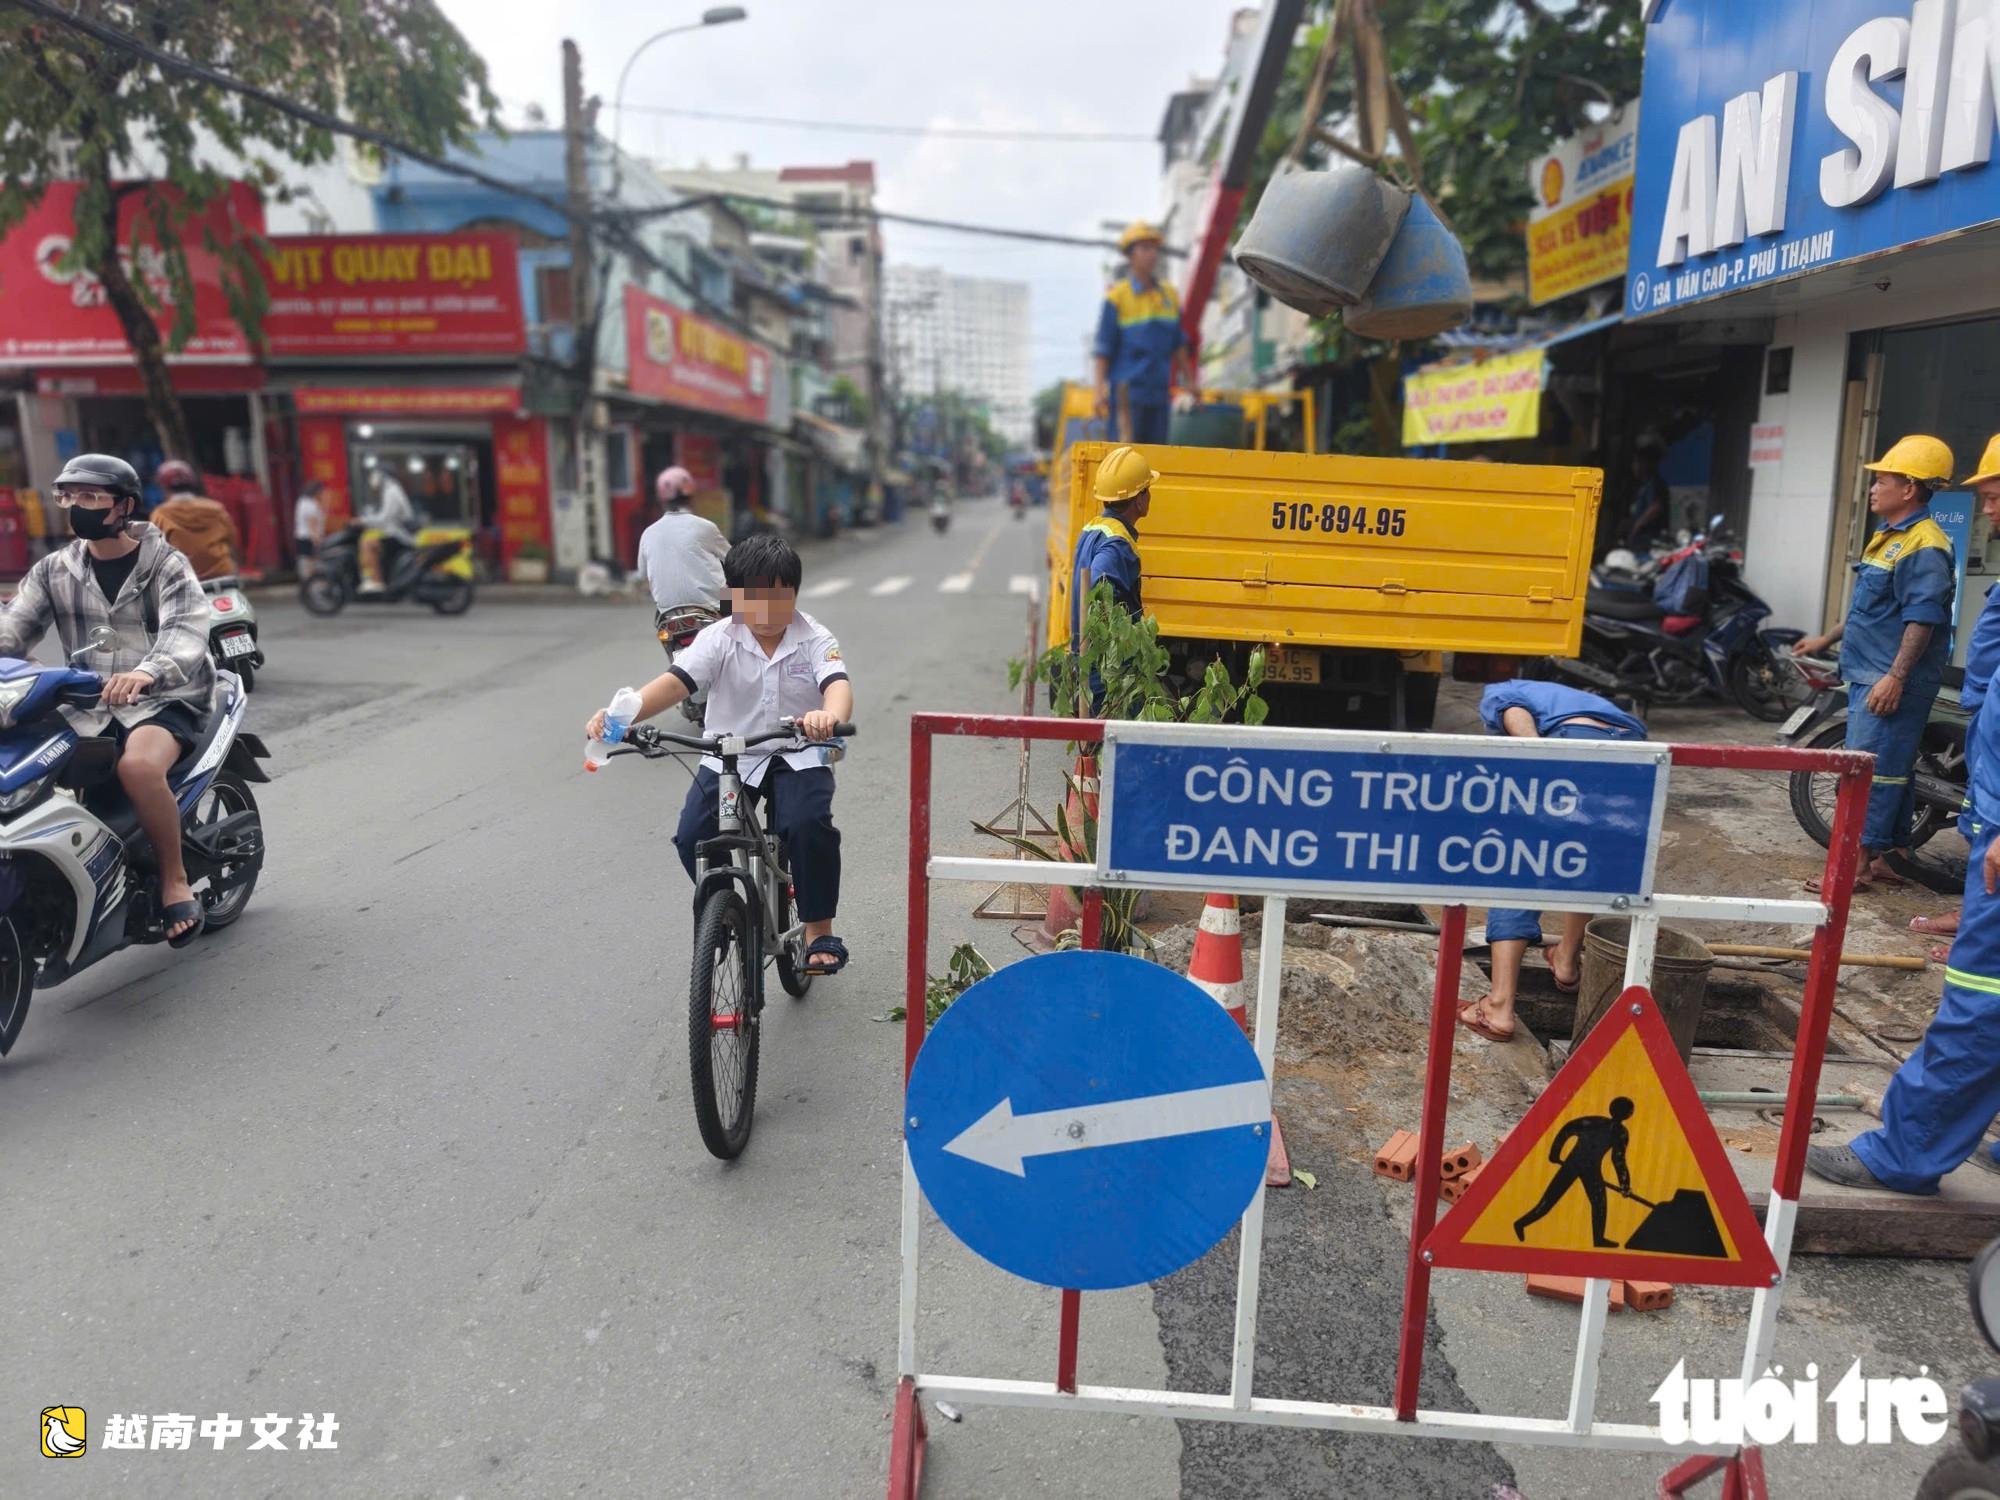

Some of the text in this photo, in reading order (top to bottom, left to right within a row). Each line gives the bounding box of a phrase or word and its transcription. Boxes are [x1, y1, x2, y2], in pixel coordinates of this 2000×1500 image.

[1656, 71, 1798, 268] AN
[271, 245, 323, 290] VỊT
[333, 244, 420, 286] QUAY
[1652, 280, 1671, 307] 13A
[1676, 267, 1700, 300] VĂN
[1748, 242, 1778, 281] PHÚ
[1781, 229, 1835, 271] THẠNH
[1934, 511, 1964, 524] For Life
[1263, 665, 1313, 682] 94.95
[37, 740, 71, 766] YAMAHA
[1183, 756, 1580, 817] CÔNG TRƯỜNG
[1165, 823, 1588, 880] ĐANG THI CÔNG
